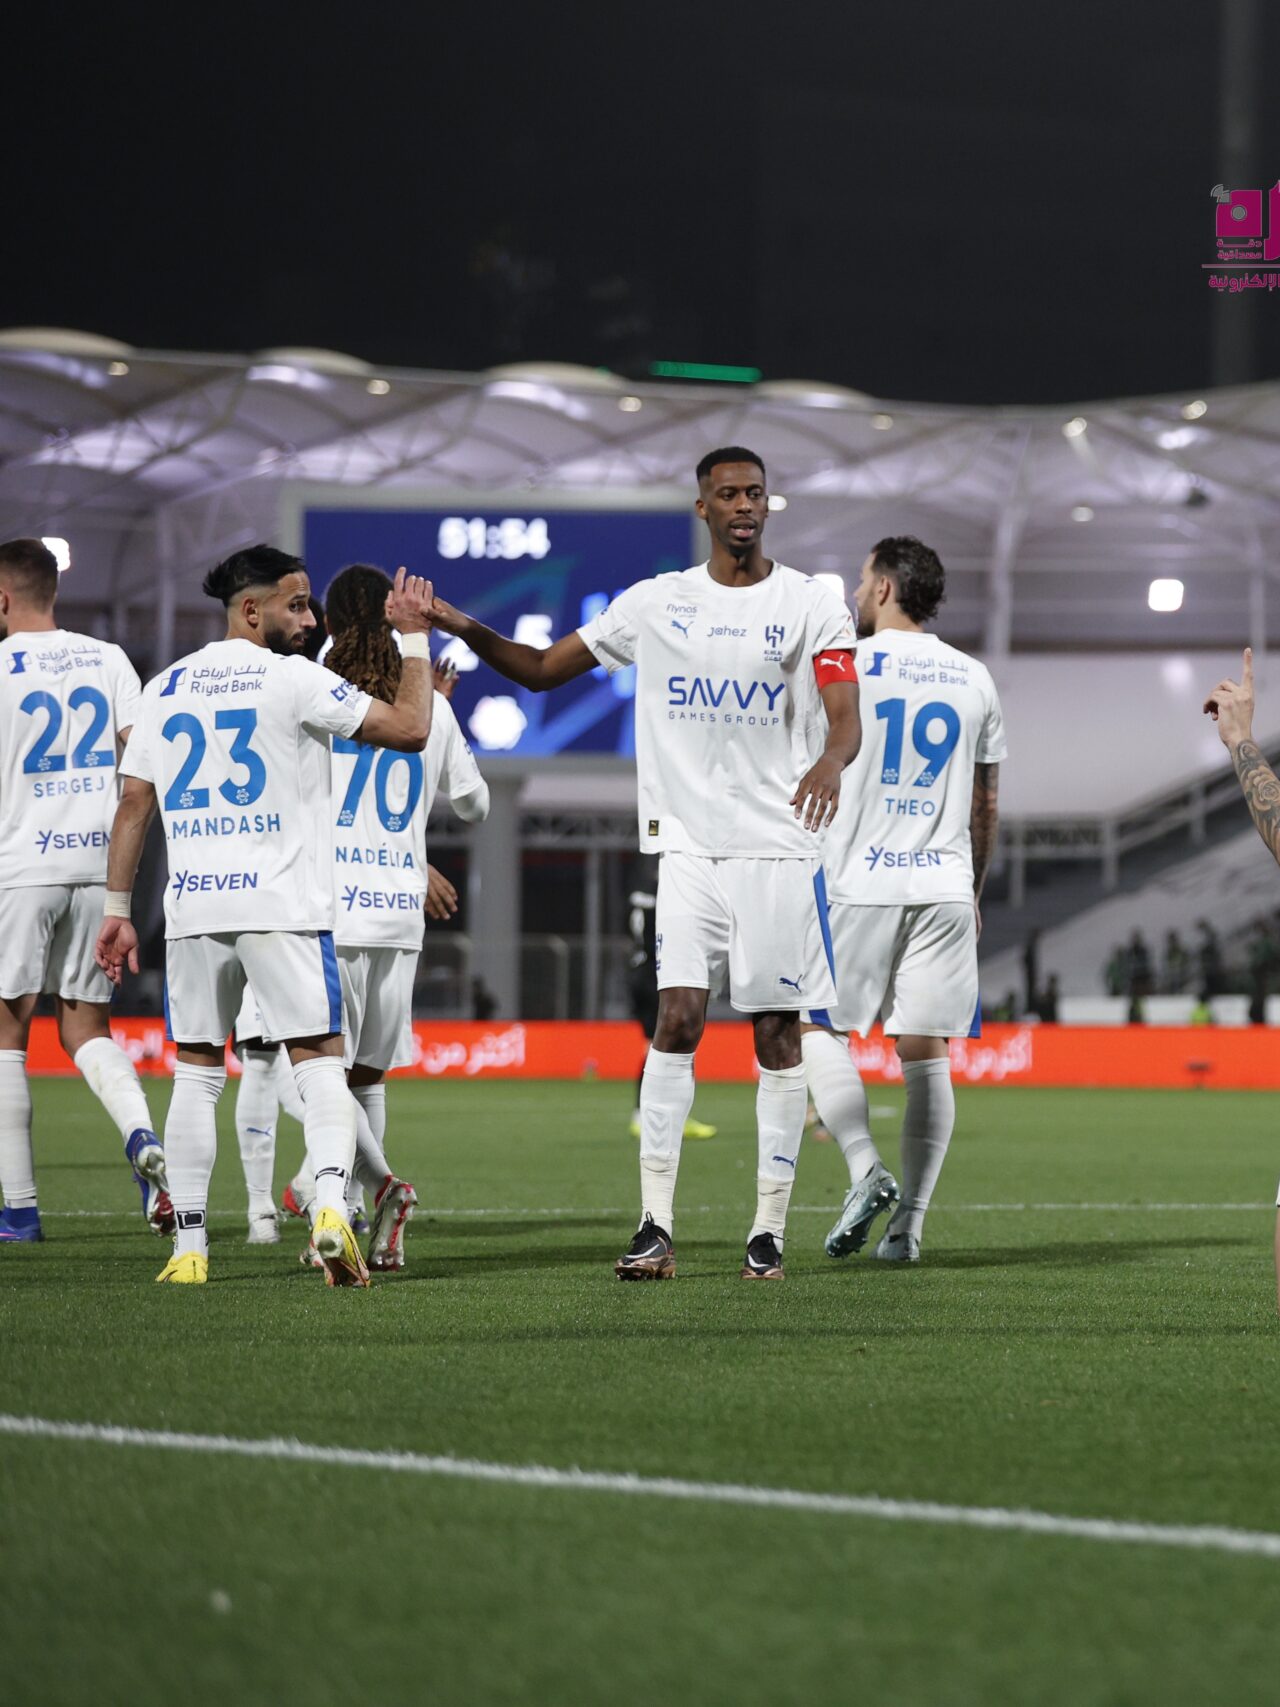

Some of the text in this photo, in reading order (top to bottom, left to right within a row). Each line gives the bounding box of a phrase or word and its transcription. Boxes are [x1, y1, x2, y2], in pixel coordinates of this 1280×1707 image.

[707, 625, 748, 637] jahez
[39, 656, 103, 676] Riyad Bank
[190, 679, 263, 696] Riyad Bank
[898, 668, 969, 686] Riyad Bank
[668, 676, 785, 711] SAVVY
[668, 711, 780, 726] GAMES GROUP
[20, 686, 115, 774] 22
[875, 698, 961, 788] 19
[161, 708, 266, 811] 23
[34, 776, 105, 798] SERGEJ
[331, 735, 424, 832] 70
[885, 798, 935, 816] THEO
